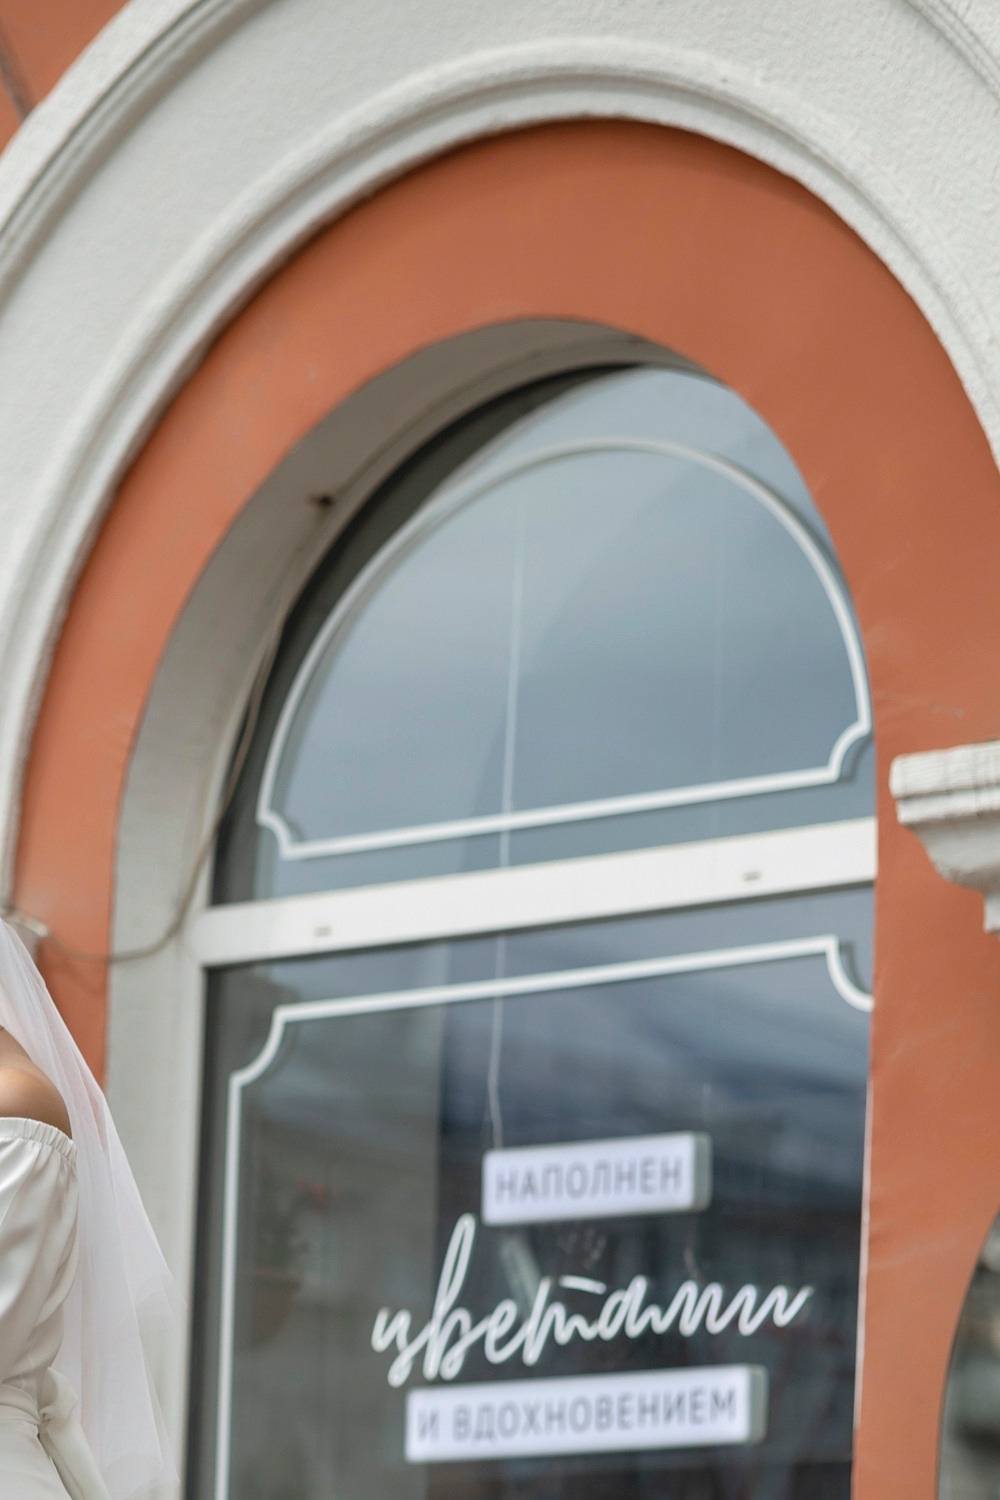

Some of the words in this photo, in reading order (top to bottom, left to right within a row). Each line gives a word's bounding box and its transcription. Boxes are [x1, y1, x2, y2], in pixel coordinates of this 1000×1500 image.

[496, 1156, 684, 1198] НАПОЛНЕН
[371, 1213, 814, 1387] цветами
[417, 1408, 440, 1442] И
[452, 1386, 736, 1444] ВДОХНОВЕНИЕМ
